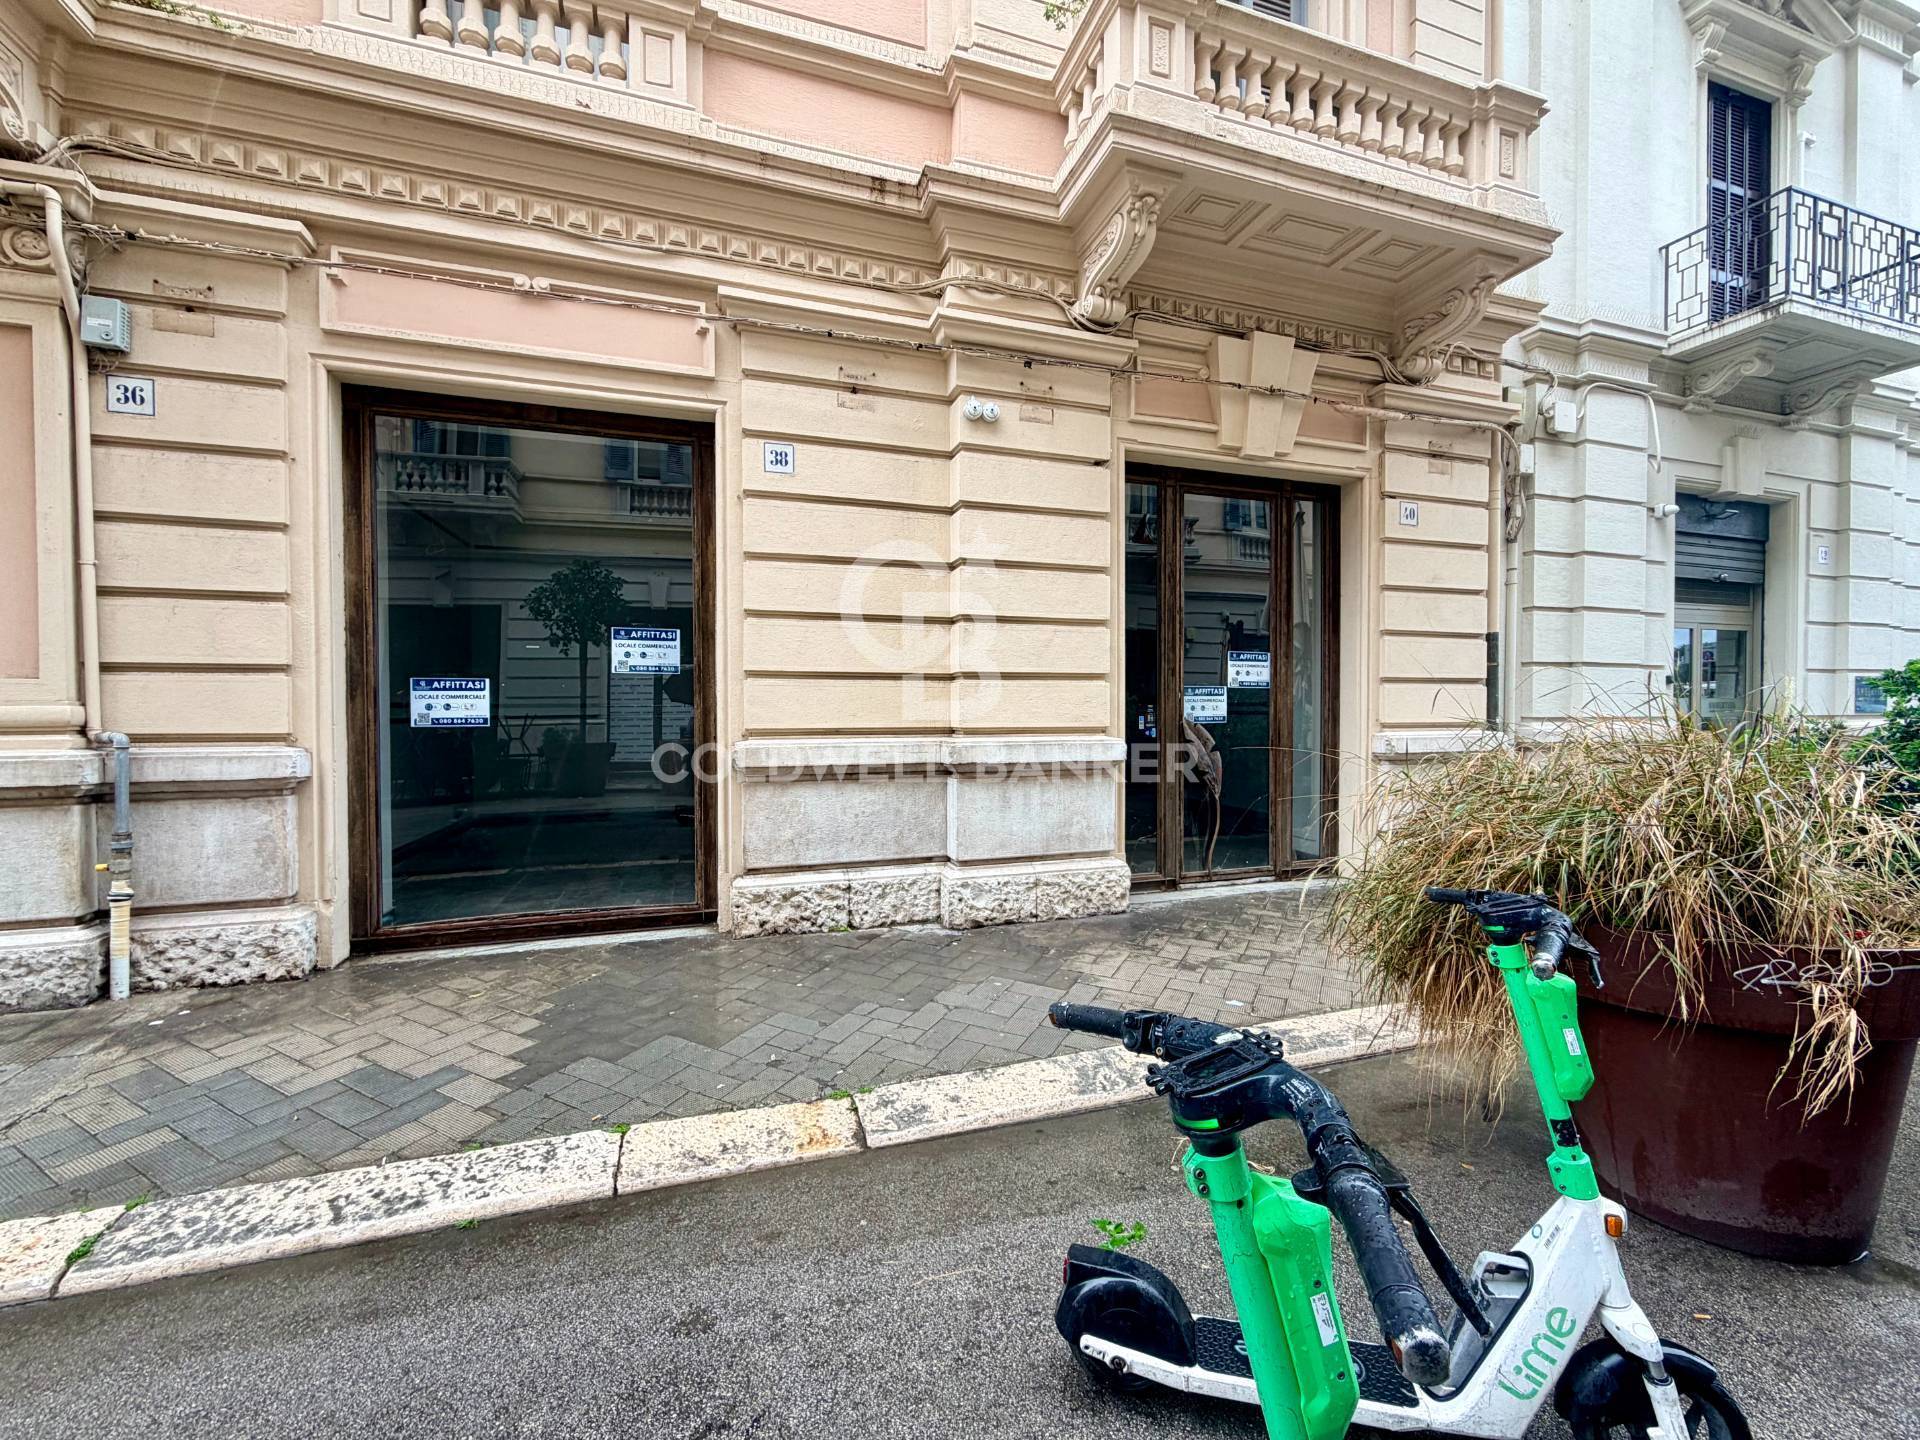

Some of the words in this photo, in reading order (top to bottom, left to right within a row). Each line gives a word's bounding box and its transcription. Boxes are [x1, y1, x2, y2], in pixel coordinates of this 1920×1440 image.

[116, 384, 145, 406] 36
[770, 450, 789, 467] 38
[1402, 506, 1415, 521] 40
[630, 630, 676, 639] AFFITTASI
[432, 681, 484, 689] AFFITTASI
